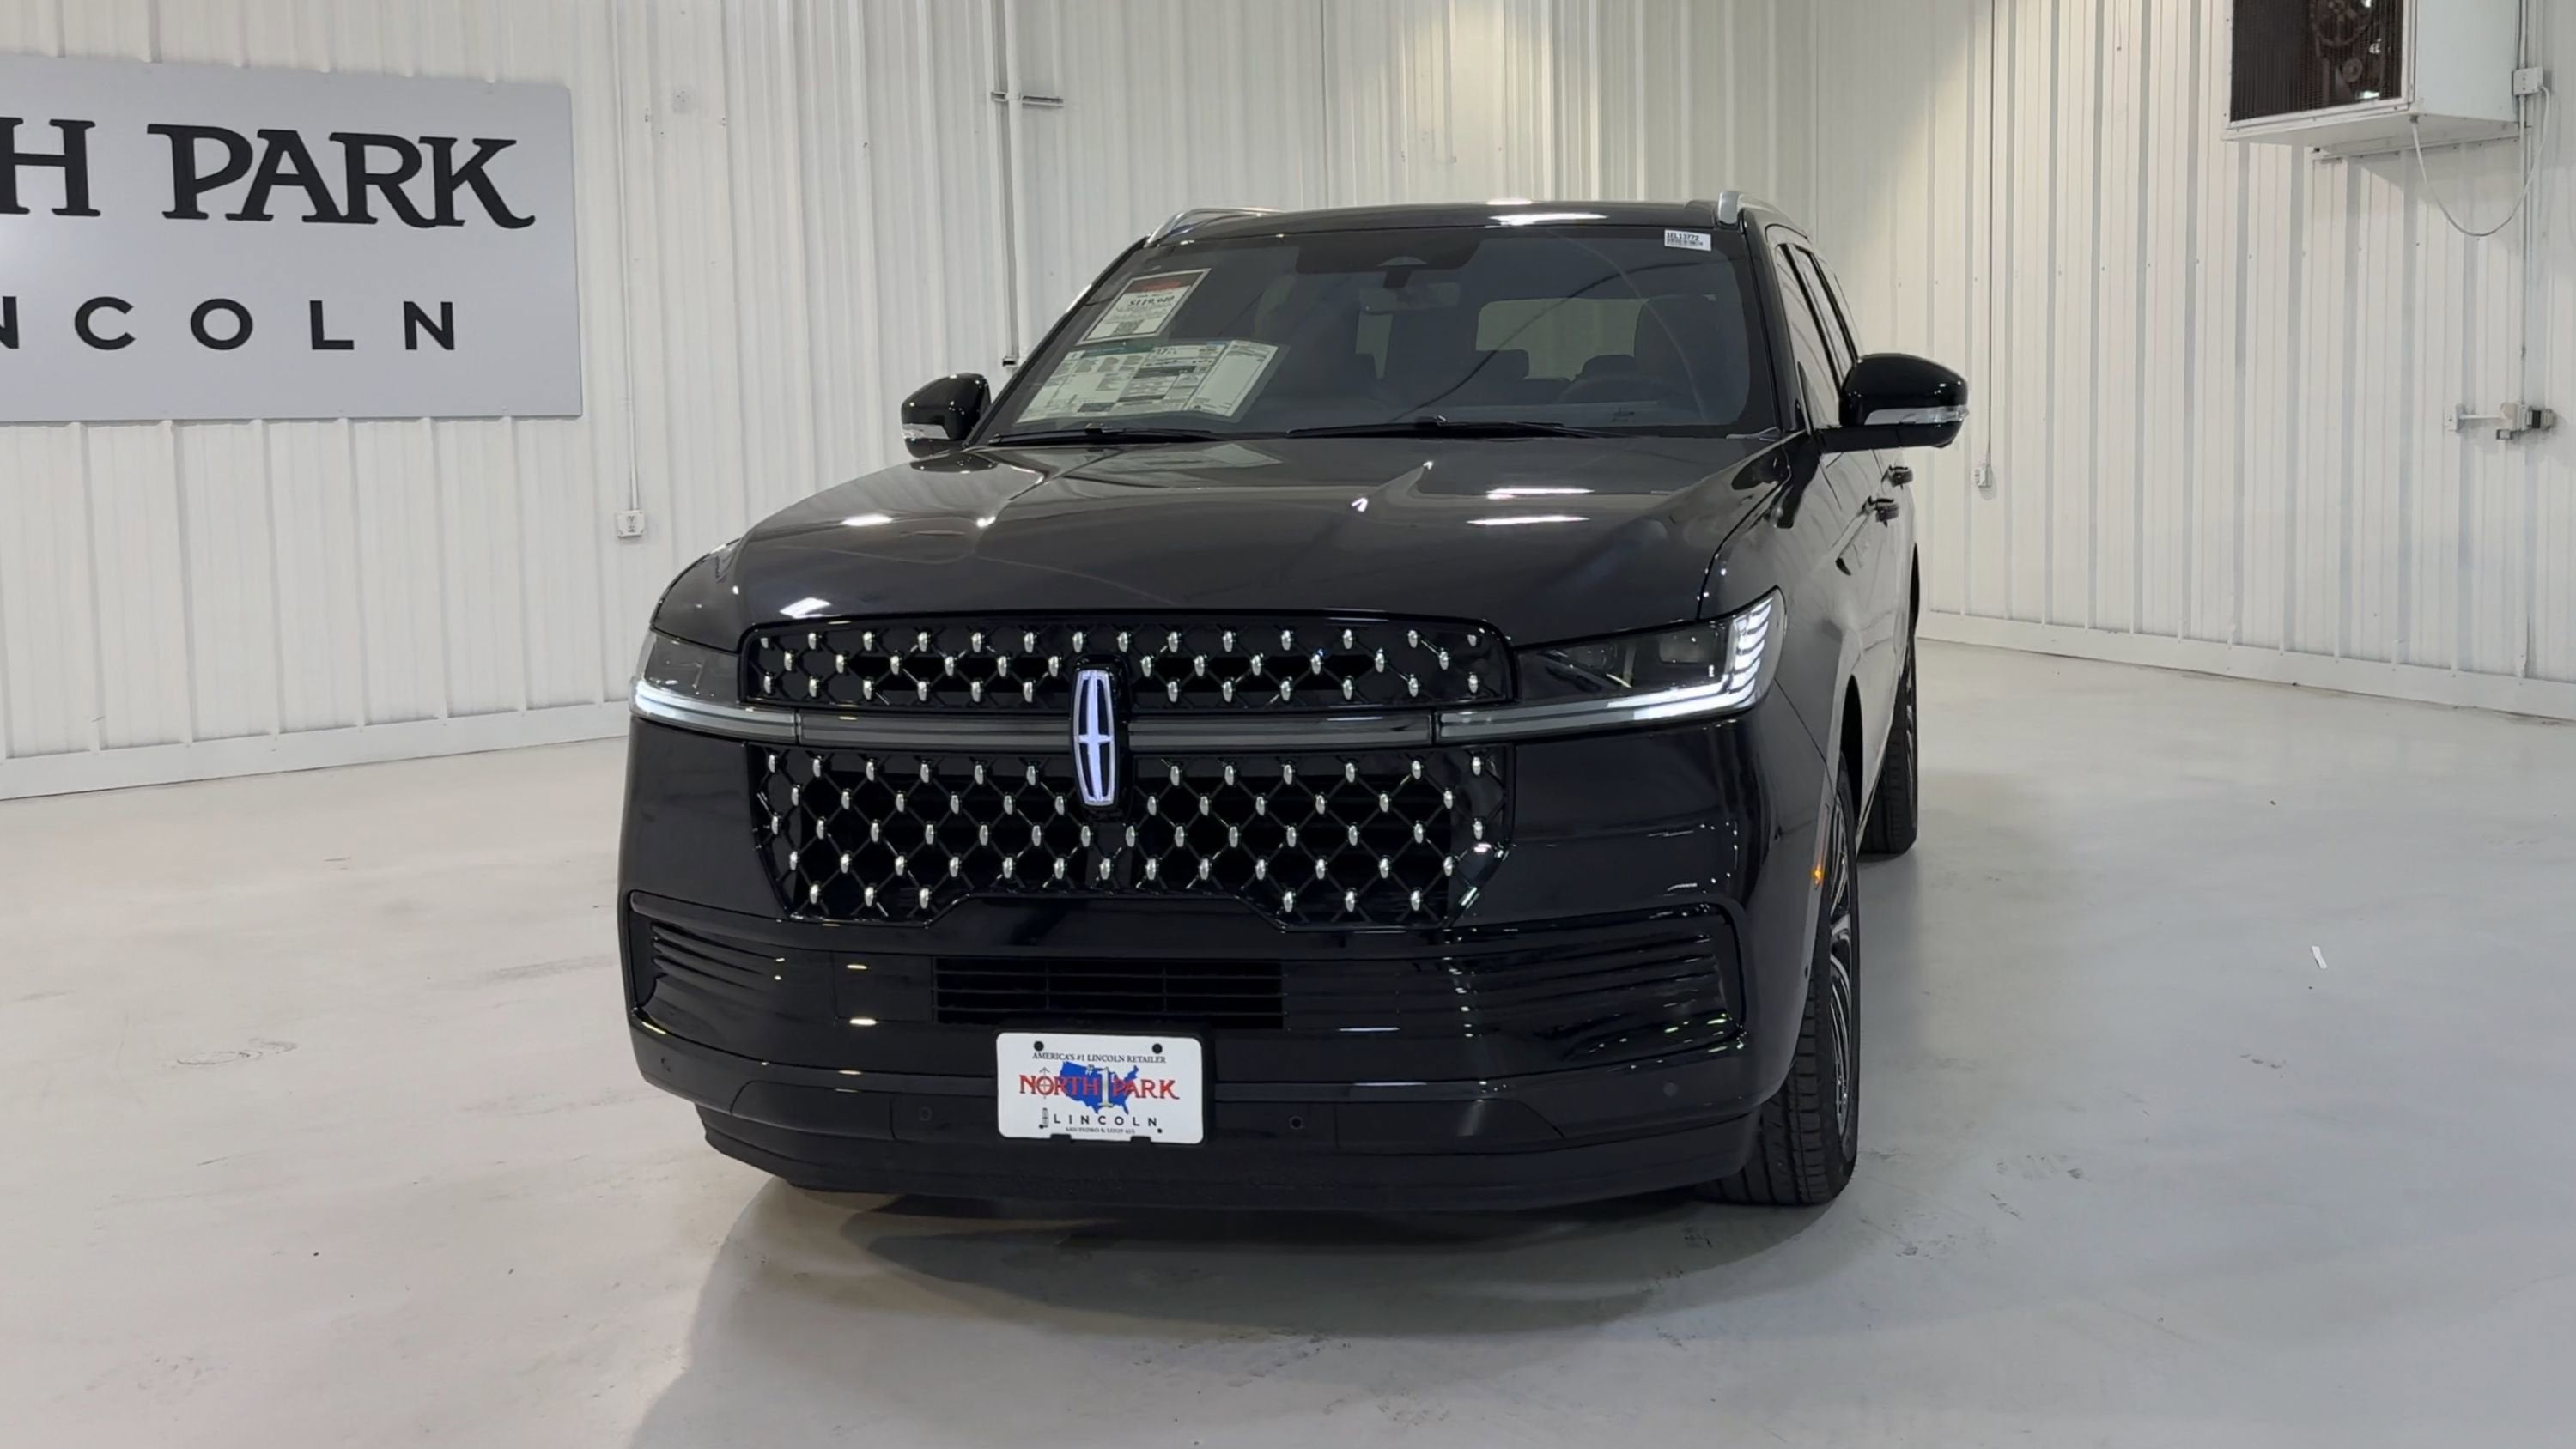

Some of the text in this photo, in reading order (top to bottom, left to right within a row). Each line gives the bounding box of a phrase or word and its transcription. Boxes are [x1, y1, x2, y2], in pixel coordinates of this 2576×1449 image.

[147, 124, 536, 229] PARK
[1032, 1052, 1075, 1061] AMERICA'S
[1087, 1053, 1125, 1063] LINCOLN
[1127, 1055, 1166, 1064] RETAILER
[1019, 1075, 1181, 1100] NORTH PARK
[1054, 1113, 1157, 1126] LINCOLN
